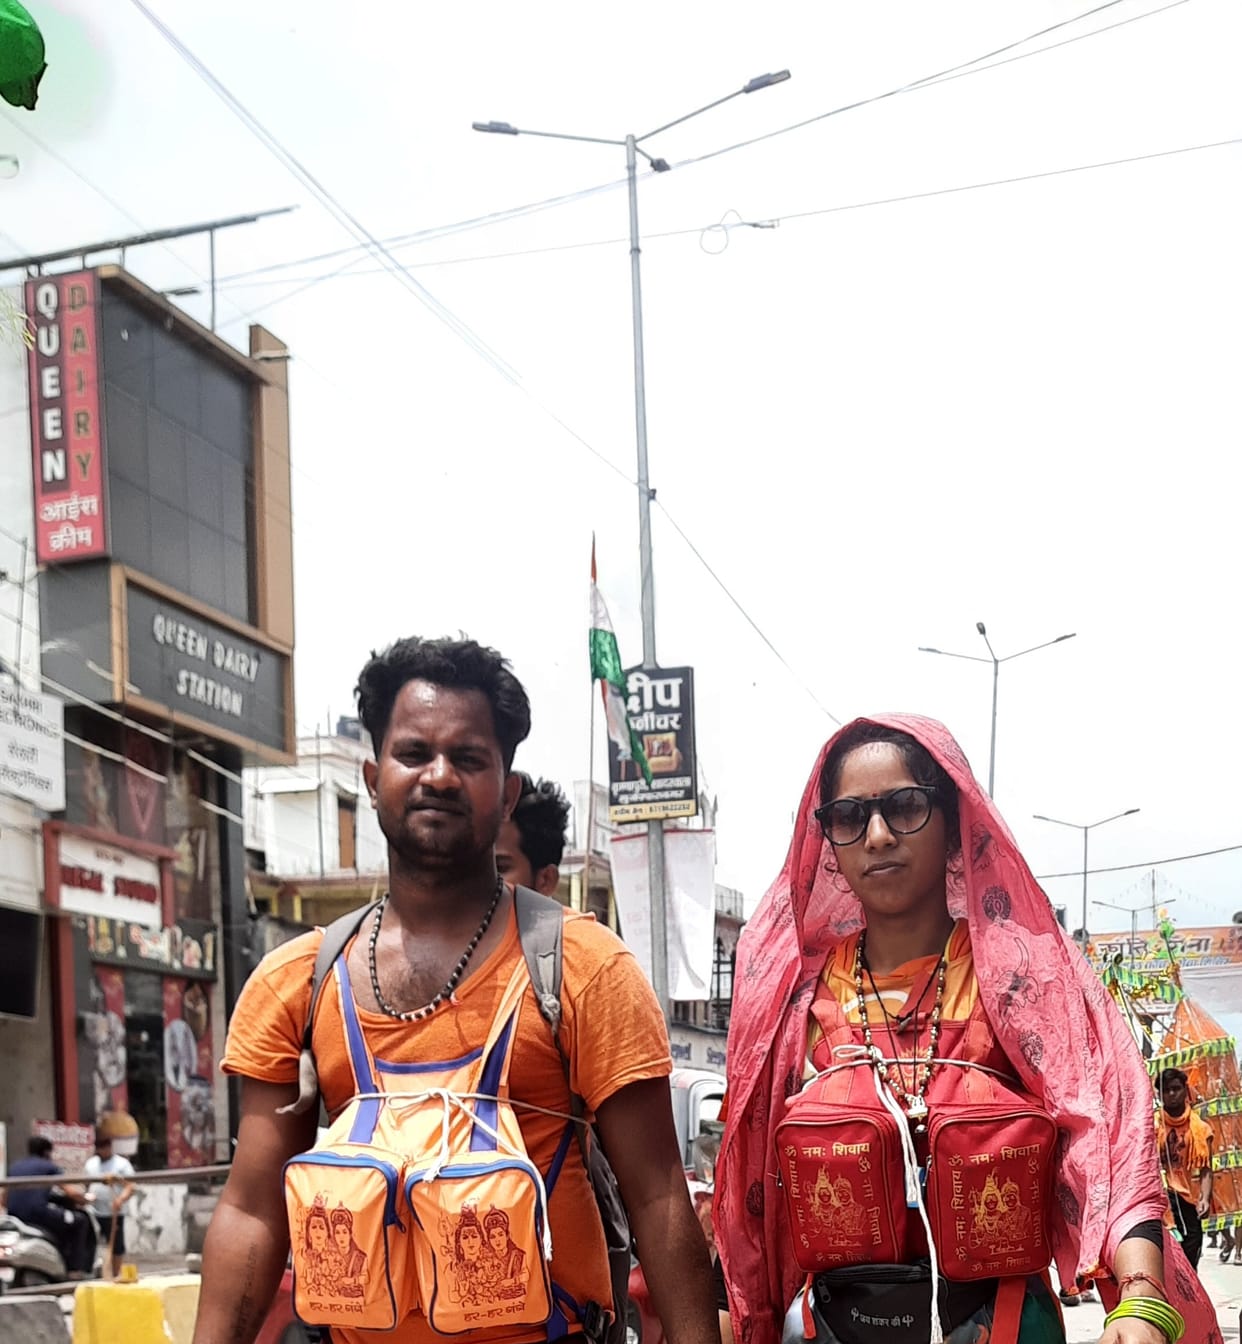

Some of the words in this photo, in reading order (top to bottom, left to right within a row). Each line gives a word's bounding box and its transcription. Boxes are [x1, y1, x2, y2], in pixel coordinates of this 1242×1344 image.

[36, 283, 66, 483] QUEEN
[67, 284, 93, 481] DAIRY
[153, 613, 208, 661] QUEEN
[213, 640, 259, 683] DAIRY
[176, 669, 243, 717] STATION
[802, 1146, 827, 1158] नमः
[832, 1141, 870, 1157] शिवाय
[968, 1152, 995, 1166] नमः
[1001, 1143, 1041, 1160] शिवाय
[951, 1170, 965, 1210] शिवाय
